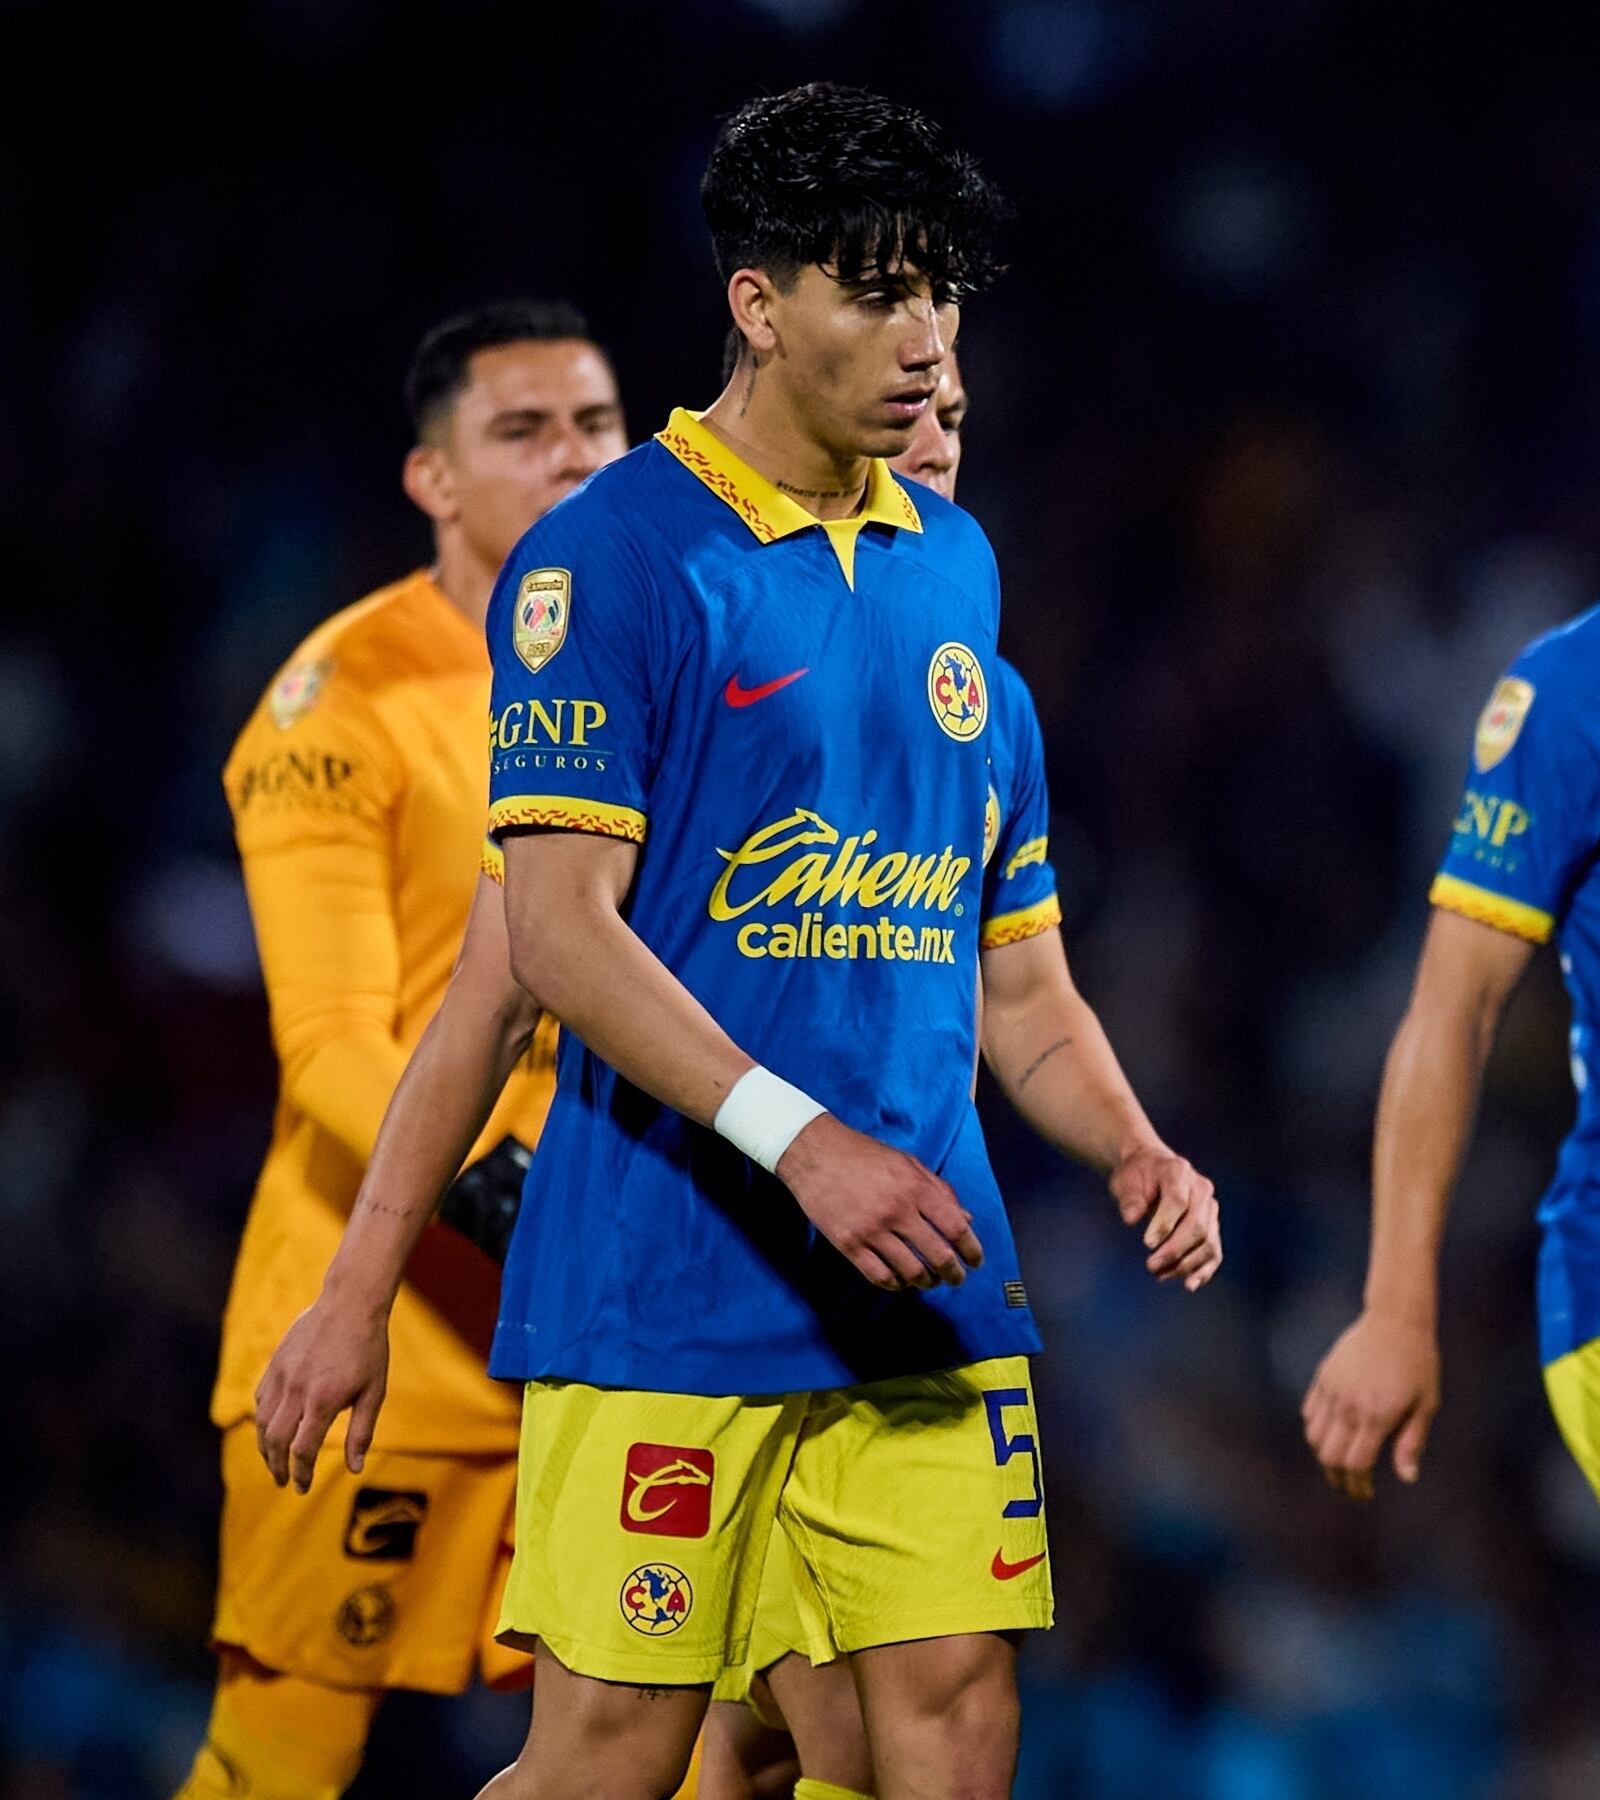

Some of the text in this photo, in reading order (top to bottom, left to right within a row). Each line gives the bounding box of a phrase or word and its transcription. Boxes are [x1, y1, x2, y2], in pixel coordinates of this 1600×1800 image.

[498, 698, 608, 750] GNP
[708, 807, 971, 922] Caliente
[736, 912, 955, 964] caliente.mx
[982, 1387, 1044, 1519] 5
